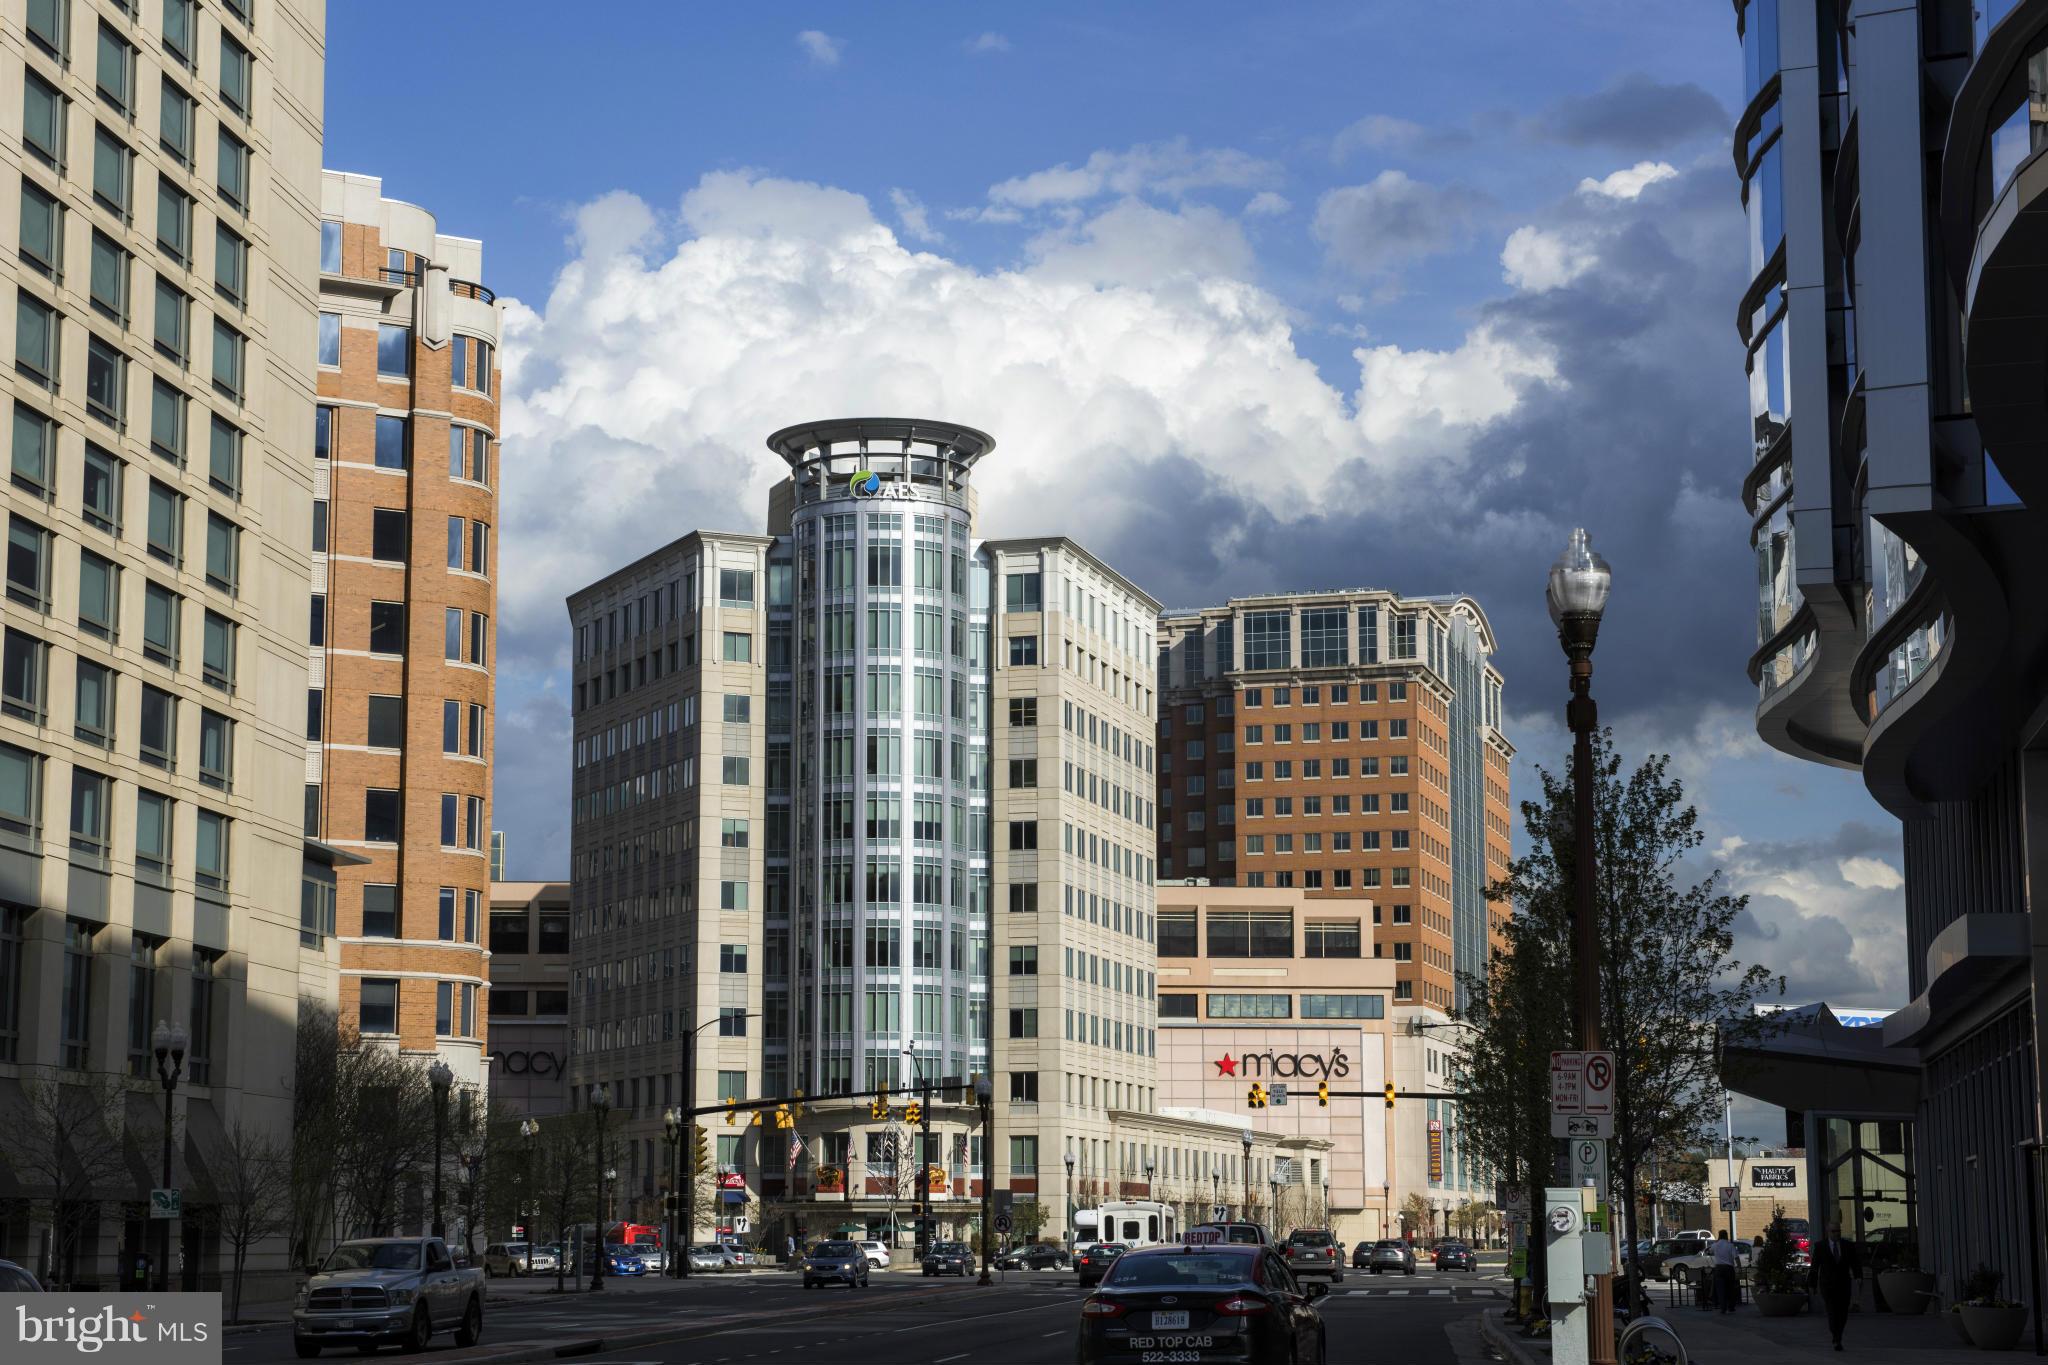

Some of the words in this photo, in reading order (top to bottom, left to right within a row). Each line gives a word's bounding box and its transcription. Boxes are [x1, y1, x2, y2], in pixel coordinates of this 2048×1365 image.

[882, 482, 920, 499] AES
[1552, 1056, 1560, 1069] NO
[1561, 1058, 1582, 1067] PARKING
[1555, 1094, 1579, 1102] MON-FRI
[1129, 1337, 1154, 1349] RED
[1157, 1336, 1183, 1348] TOP
[1185, 1336, 1213, 1348] CAB
[1142, 1351, 1201, 1362] 522-3333
